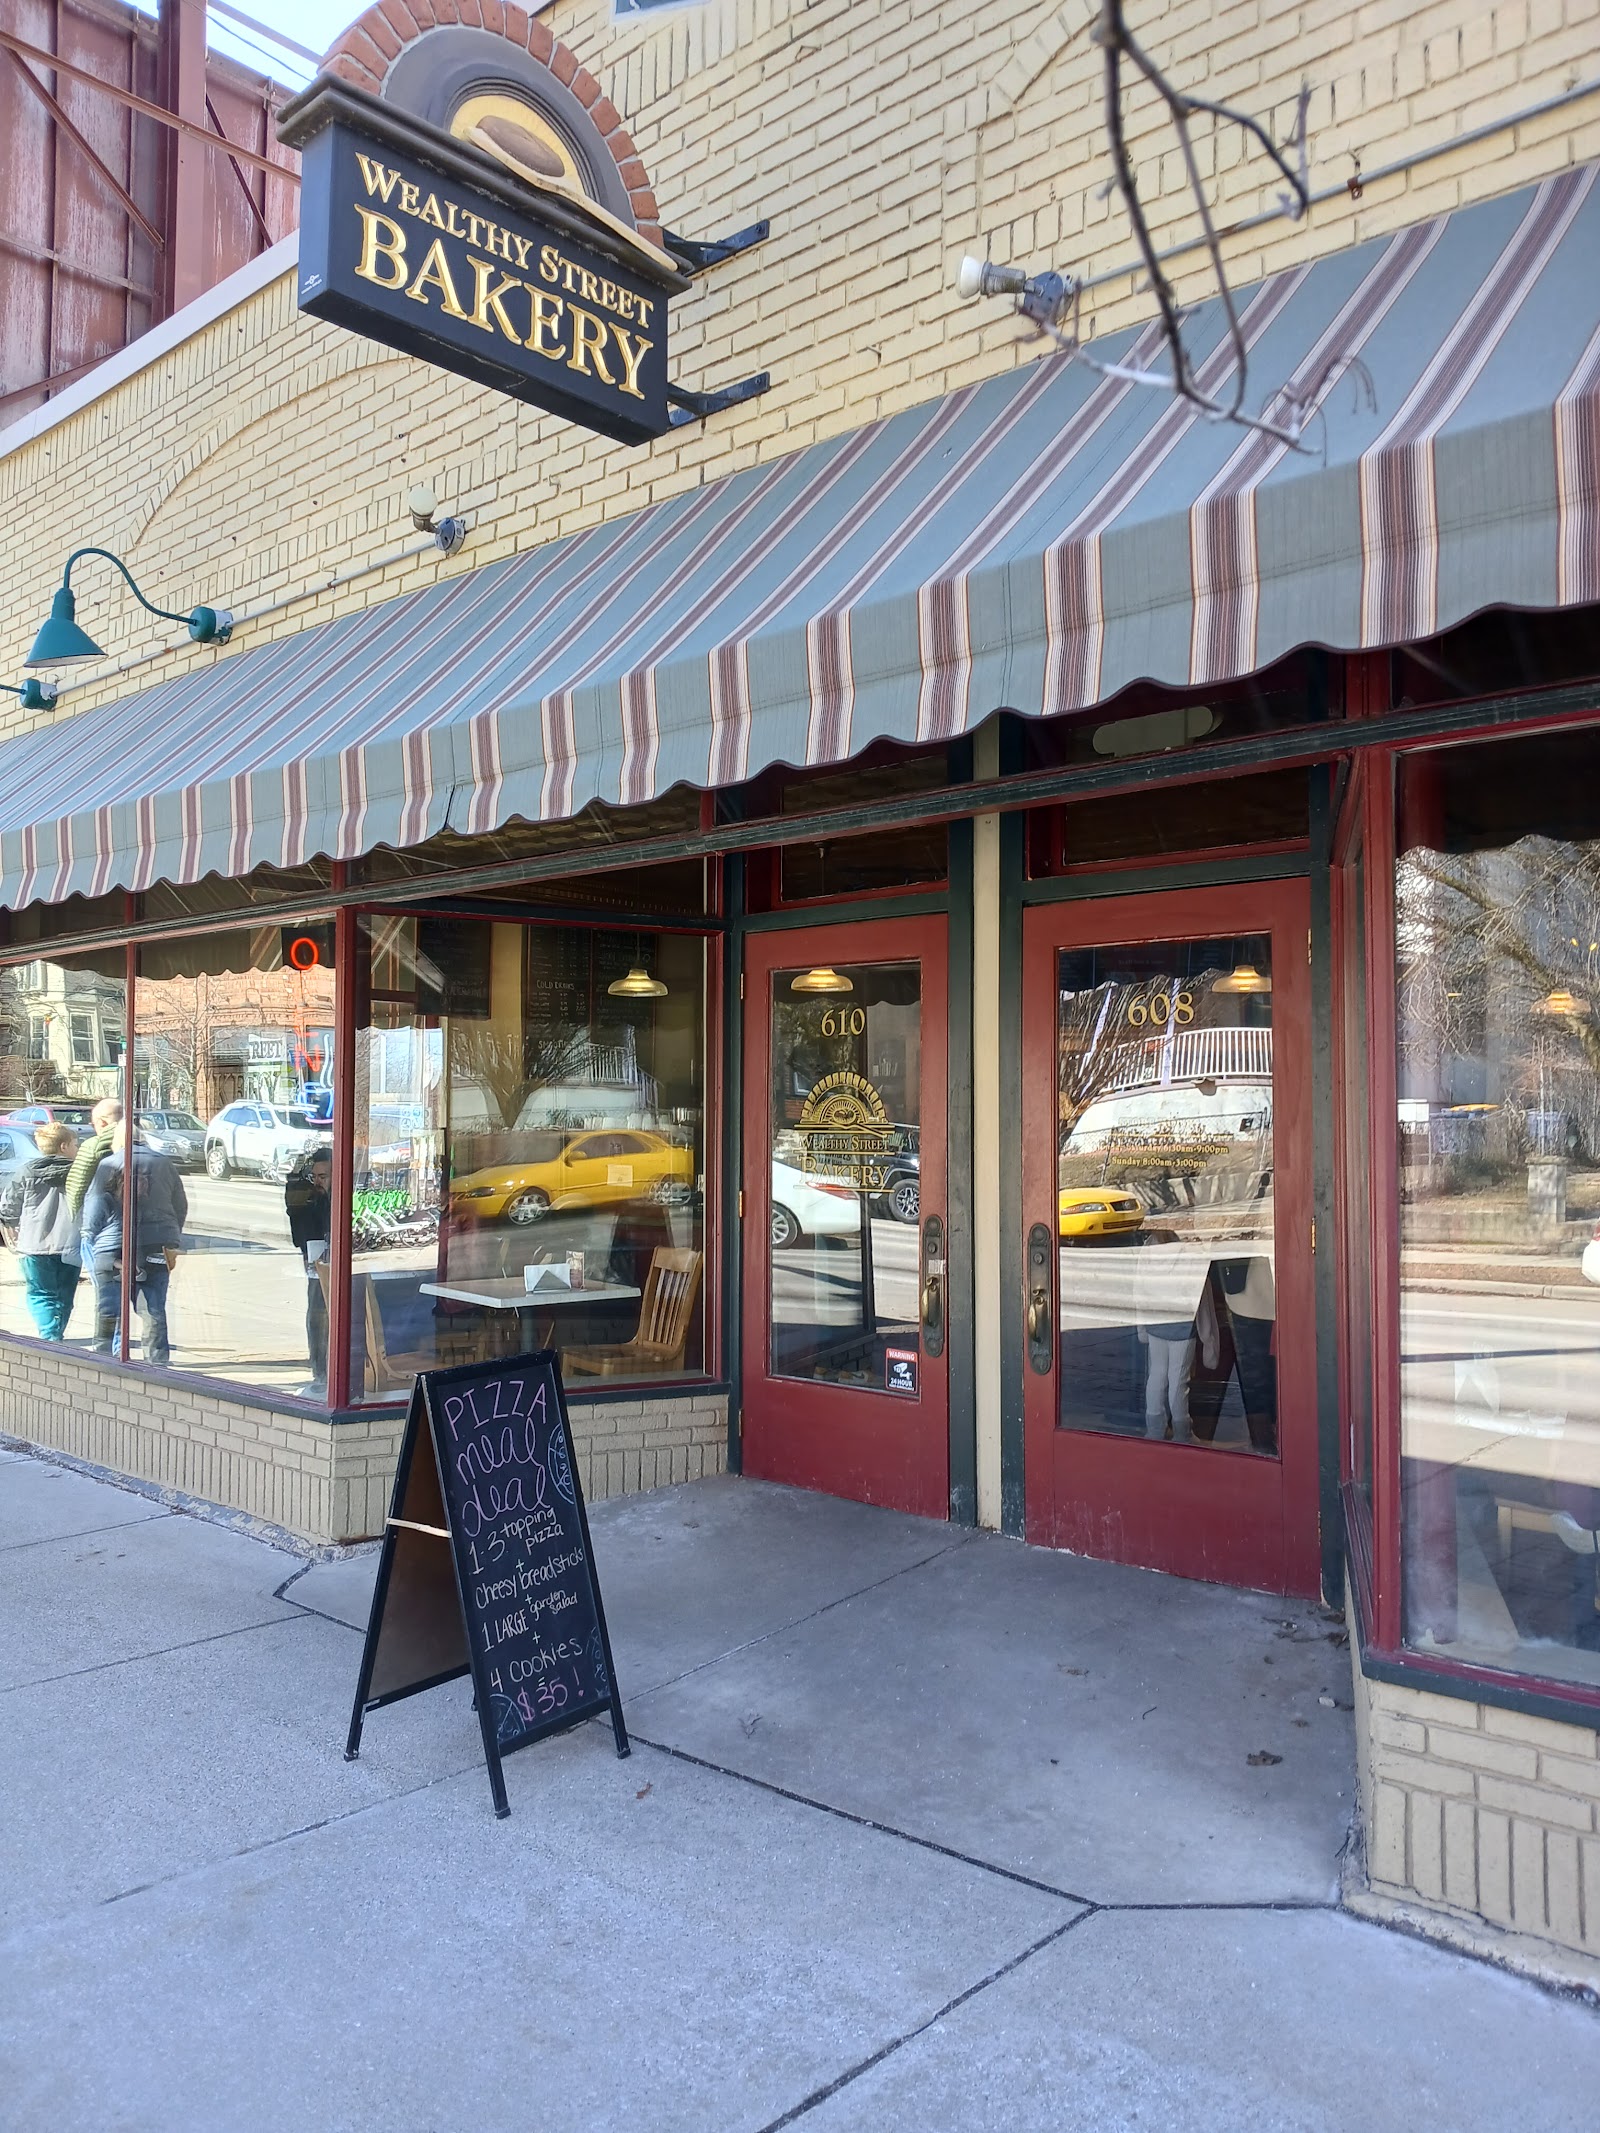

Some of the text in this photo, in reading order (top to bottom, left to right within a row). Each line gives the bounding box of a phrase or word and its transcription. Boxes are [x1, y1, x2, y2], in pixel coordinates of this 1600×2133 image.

[354, 151, 655, 329] WEALTHY STREET
[353, 203, 655, 400] BAKERY
[821, 1008, 866, 1037] 610
[1127, 991, 1195, 1026] 608
[800, 1134, 889, 1150] WEALTHY STREET
[800, 1156, 890, 1188] BAKERY
[1111, 1156, 1141, 1167] Sunday
[889, 1351, 915, 1360] WARNING
[897, 1378, 913, 1388] HOUR
[444, 1381, 547, 1441] PIZZA
[456, 1416, 541, 1485] meal
[462, 1465, 551, 1537] deal
[500, 1507, 557, 1540] topping
[525, 1524, 564, 1556] pizza
[549, 1592, 578, 1615] salad
[481, 1590, 566, 1652] 1 LARGE garden
[490, 1667, 503, 1693] 4
